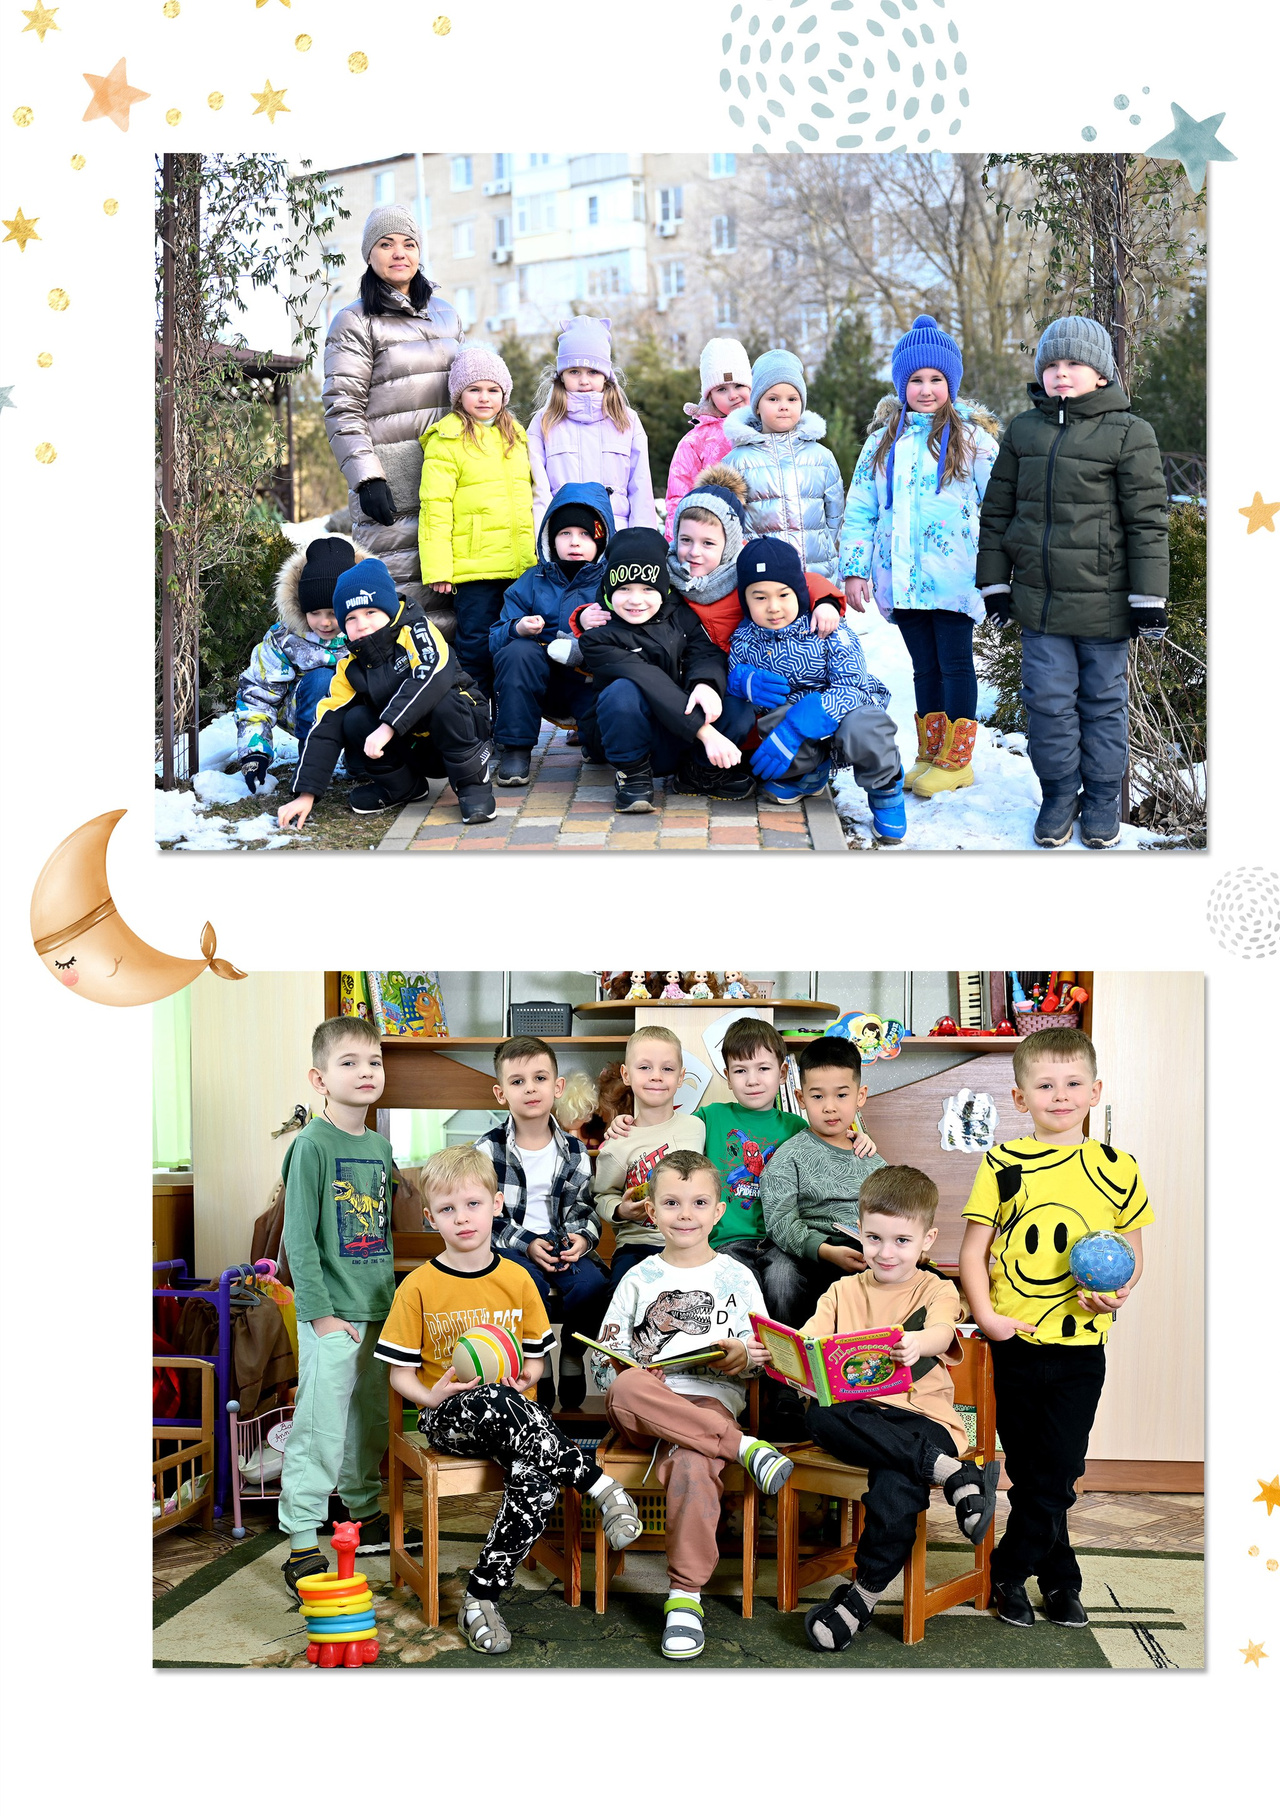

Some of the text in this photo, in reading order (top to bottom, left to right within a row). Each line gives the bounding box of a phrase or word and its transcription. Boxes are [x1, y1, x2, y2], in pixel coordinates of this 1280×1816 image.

[609, 564, 660, 586] OOPS!
[345, 595, 369, 609] PUMA
[734, 1186, 760, 1197] SPIDER-
[378, 1171, 386, 1228] ROAR
[857, 1344, 893, 1352] поросён
